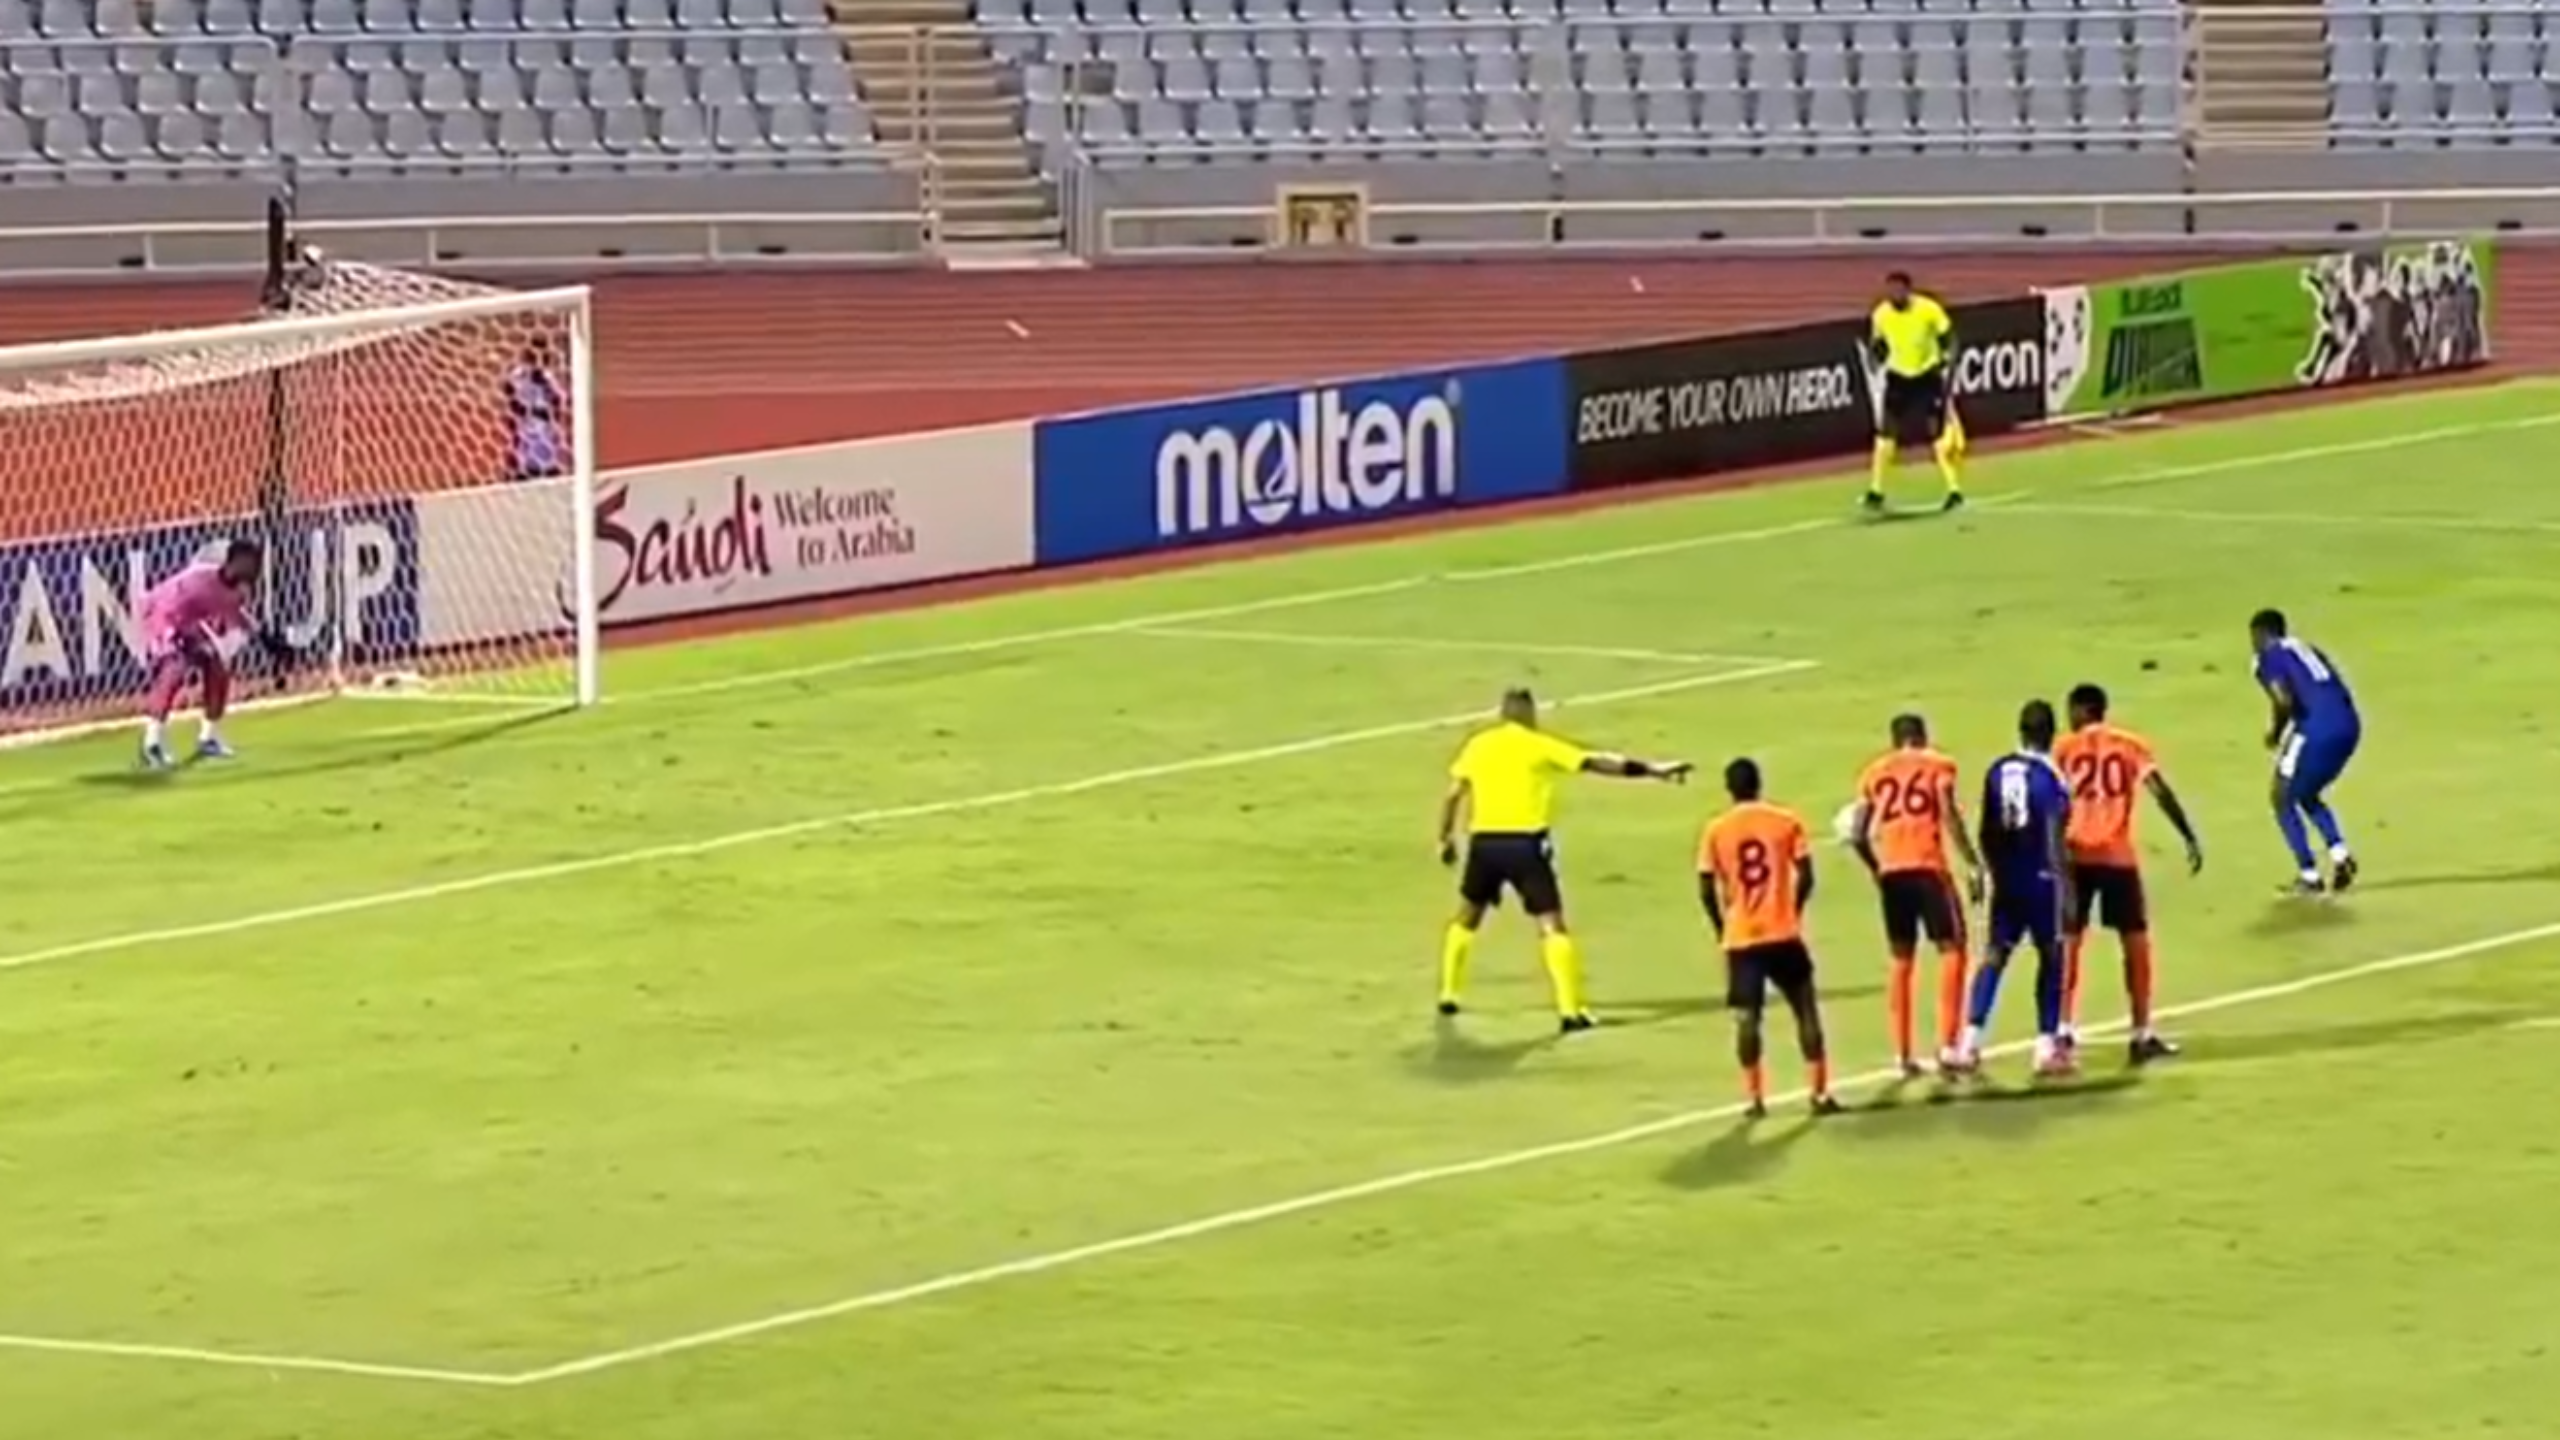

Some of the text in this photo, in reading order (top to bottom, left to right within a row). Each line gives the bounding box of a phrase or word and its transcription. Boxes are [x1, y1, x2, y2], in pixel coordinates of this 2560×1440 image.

[1578, 363, 1853, 443] BECOME YOUR OWN HERO.
[1157, 389, 1454, 535] molten
[774, 485, 896, 529] Welcome
[798, 516, 914, 570] to Arabia
[1874, 769, 1933, 823] 26
[2071, 752, 2129, 801] 20
[1738, 838, 1770, 889] 8
